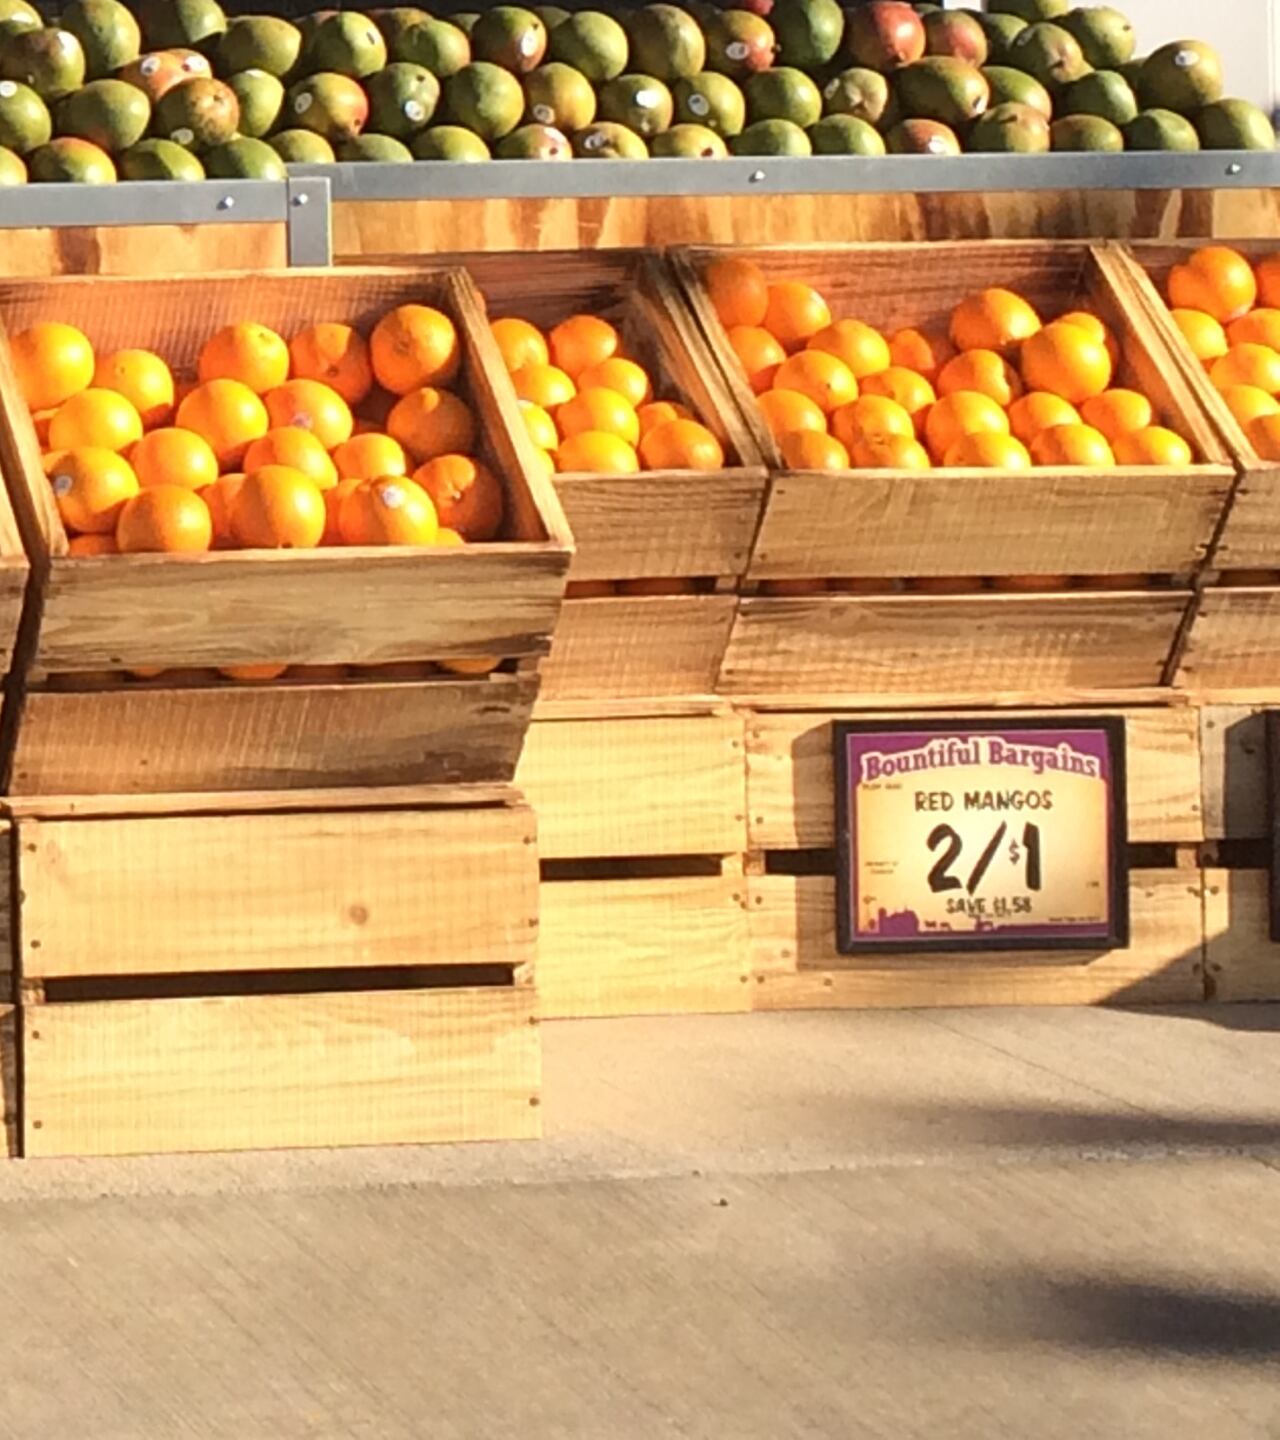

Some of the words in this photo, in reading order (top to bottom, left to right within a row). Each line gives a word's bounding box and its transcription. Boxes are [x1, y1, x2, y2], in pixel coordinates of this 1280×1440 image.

[865, 741, 980, 781] Bountiful
[989, 741, 1097, 777] Bargains
[914, 791, 954, 812] RED
[964, 789, 1054, 810] MANGOS
[926, 820, 1042, 896] 2/$1
[946, 897, 986, 914] SAVE
